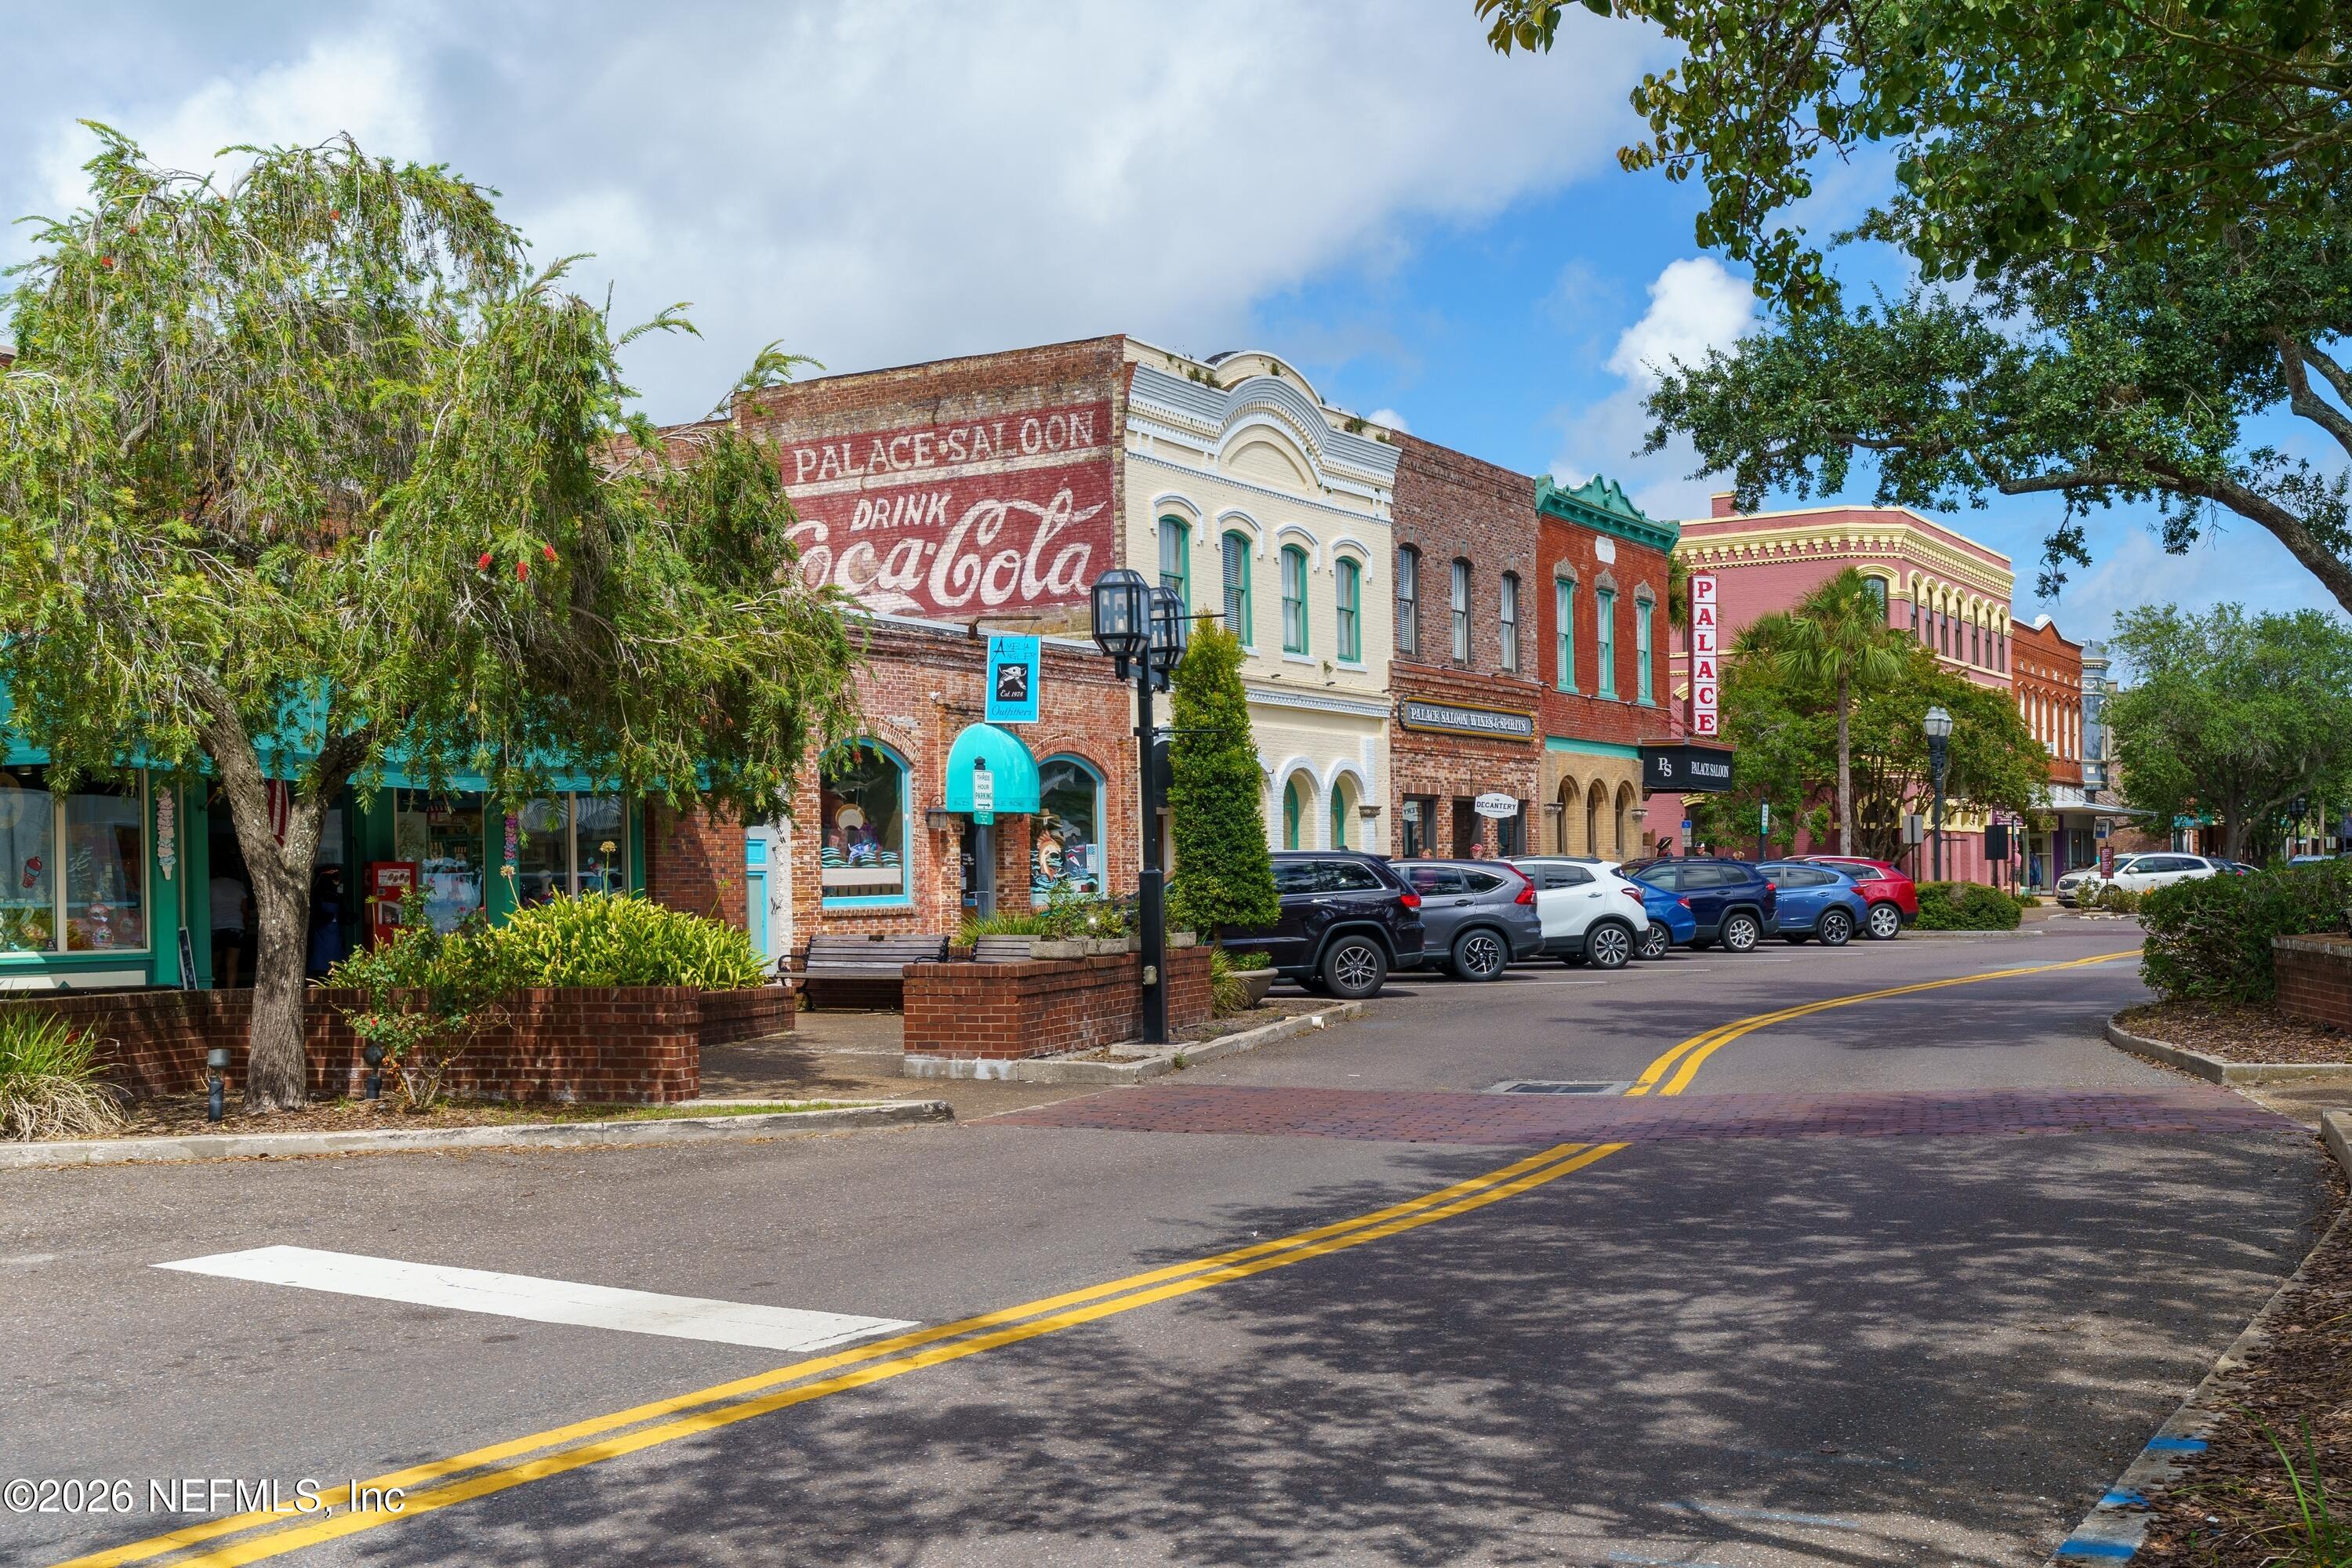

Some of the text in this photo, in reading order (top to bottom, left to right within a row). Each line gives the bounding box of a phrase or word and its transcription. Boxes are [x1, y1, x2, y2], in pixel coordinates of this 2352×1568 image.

[794, 410, 1096, 483] PALACE SALOON
[849, 492, 952, 532] DRINK
[1696, 581, 1715, 731] PALACE
[991, 704, 1033, 719] Outfitters
[1410, 707, 1439, 722] PALACE
[1441, 710, 1468, 726] SALOON
[1691, 761, 1730, 778] PALACE SALOON
[1476, 800, 1516, 811] DECANTERY
